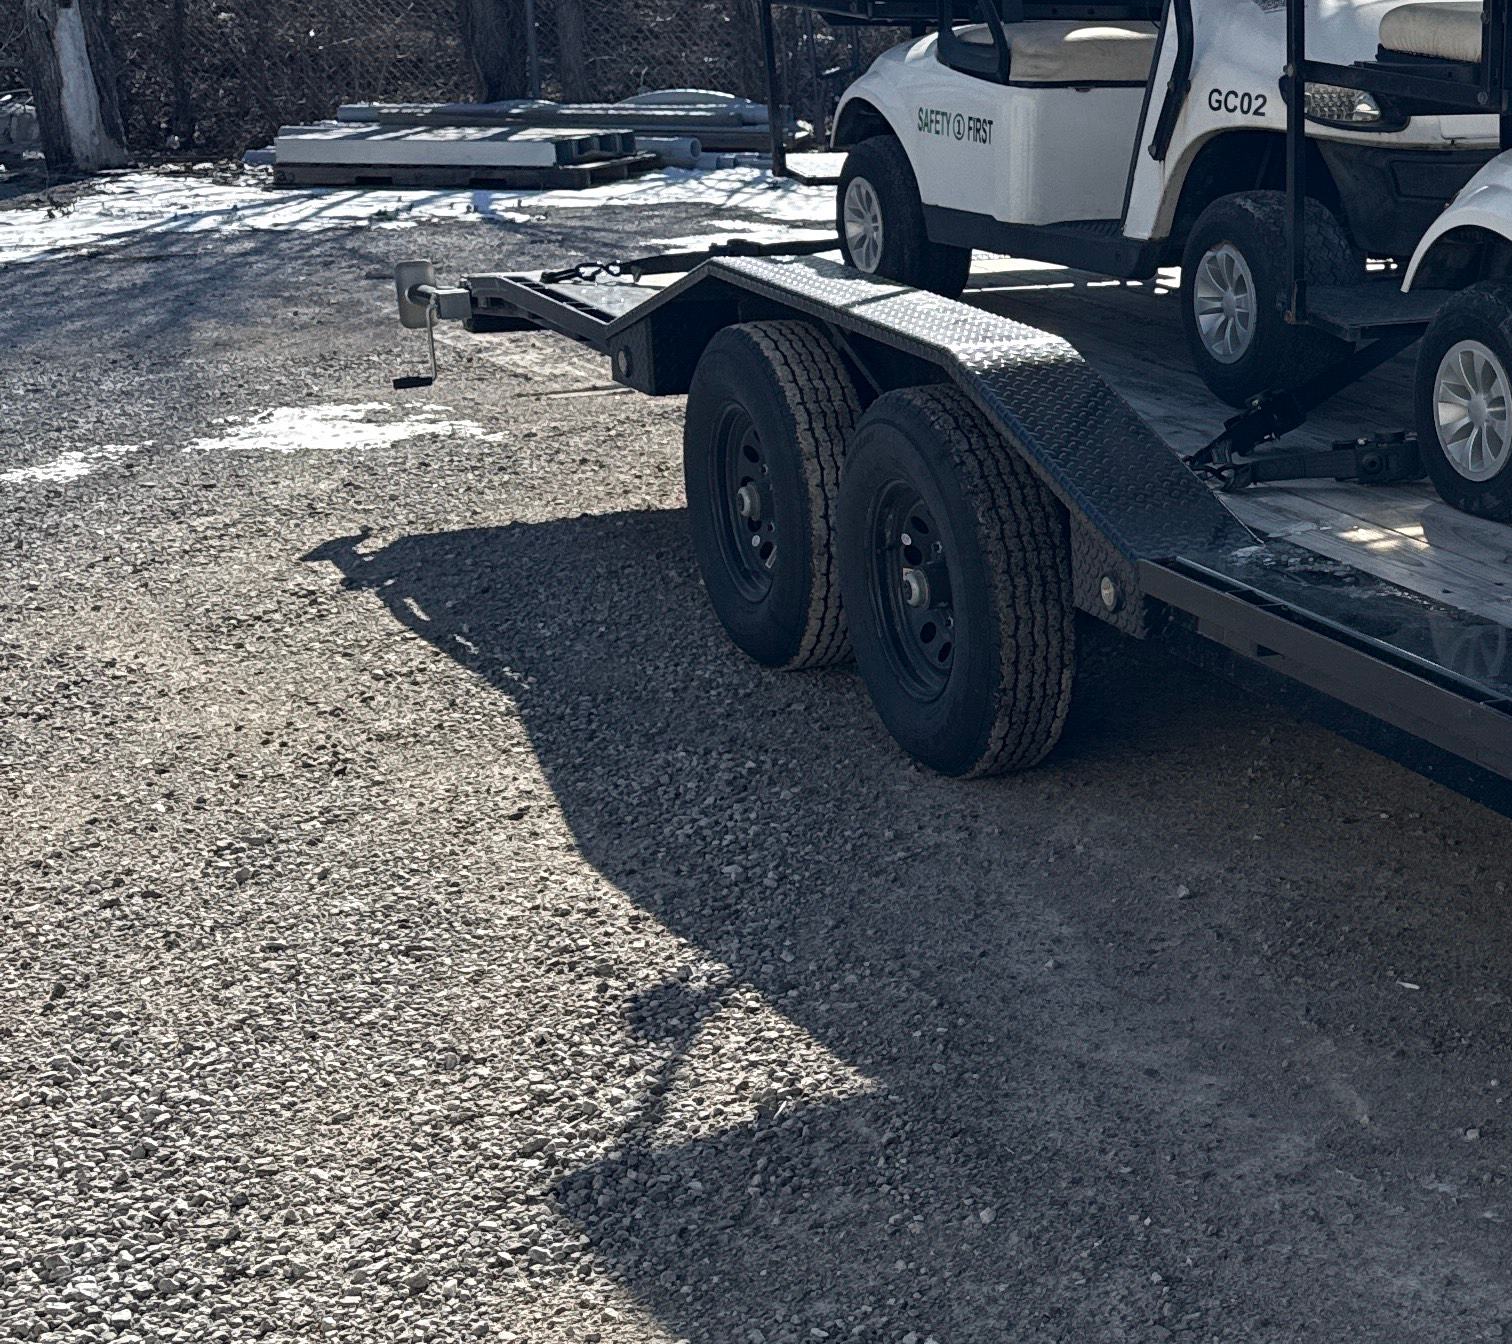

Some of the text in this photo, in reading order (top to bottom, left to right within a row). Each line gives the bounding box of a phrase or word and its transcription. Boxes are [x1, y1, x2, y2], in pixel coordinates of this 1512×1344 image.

[1208, 88, 1267, 117] GC02
[917, 106, 951, 138] SAFETY
[967, 116, 993, 145] FIRST
